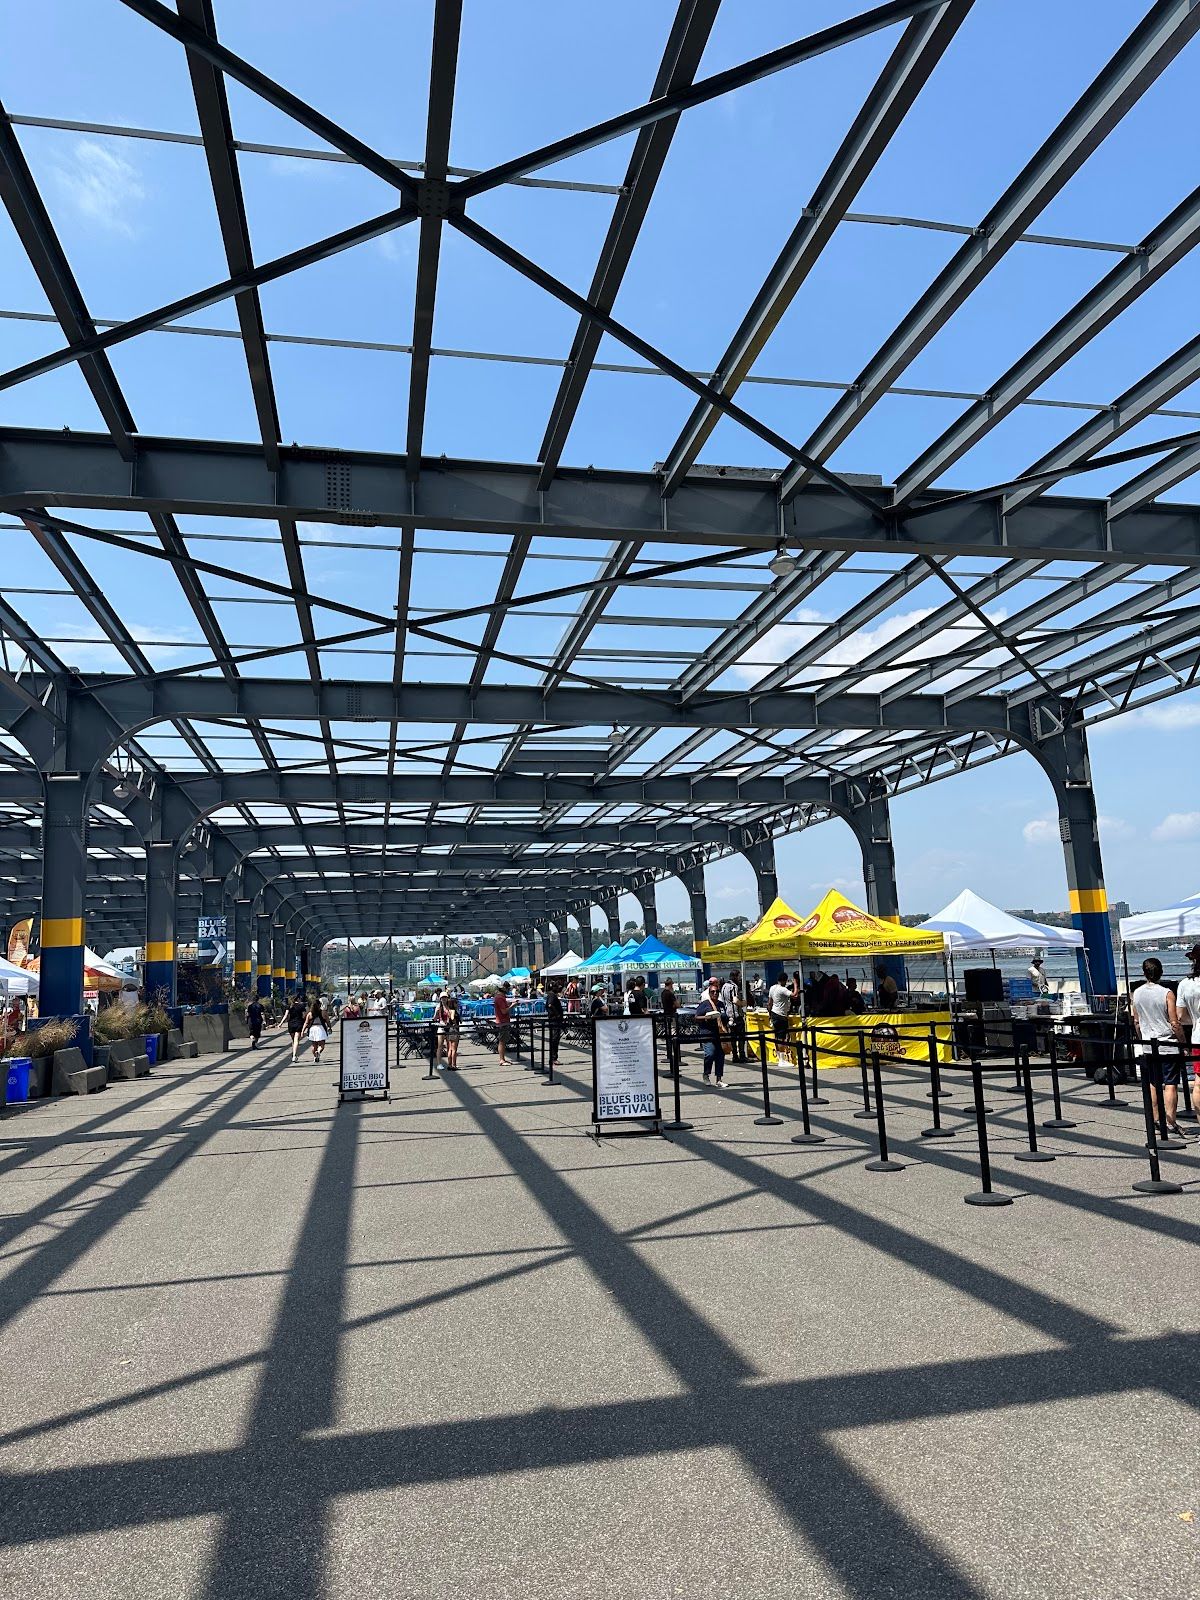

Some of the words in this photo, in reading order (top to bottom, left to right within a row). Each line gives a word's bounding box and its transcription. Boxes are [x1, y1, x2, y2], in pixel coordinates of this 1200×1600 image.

[198, 919, 227, 927] BLUES
[198, 927, 227, 938] BAR
[846, 940, 882, 948] SEASONED
[895, 939, 936, 947] PERFECTION
[626, 961, 661, 970] HUDSON
[663, 961, 688, 969] RIVER
[343, 1073, 366, 1081] BLUES
[368, 1072, 384, 1080] BBQ
[343, 1080, 384, 1088] FESTIVAL
[599, 1095, 631, 1105] BLUES
[633, 1094, 654, 1103] BBQ
[599, 1103, 654, 1115] FESTIVAL
